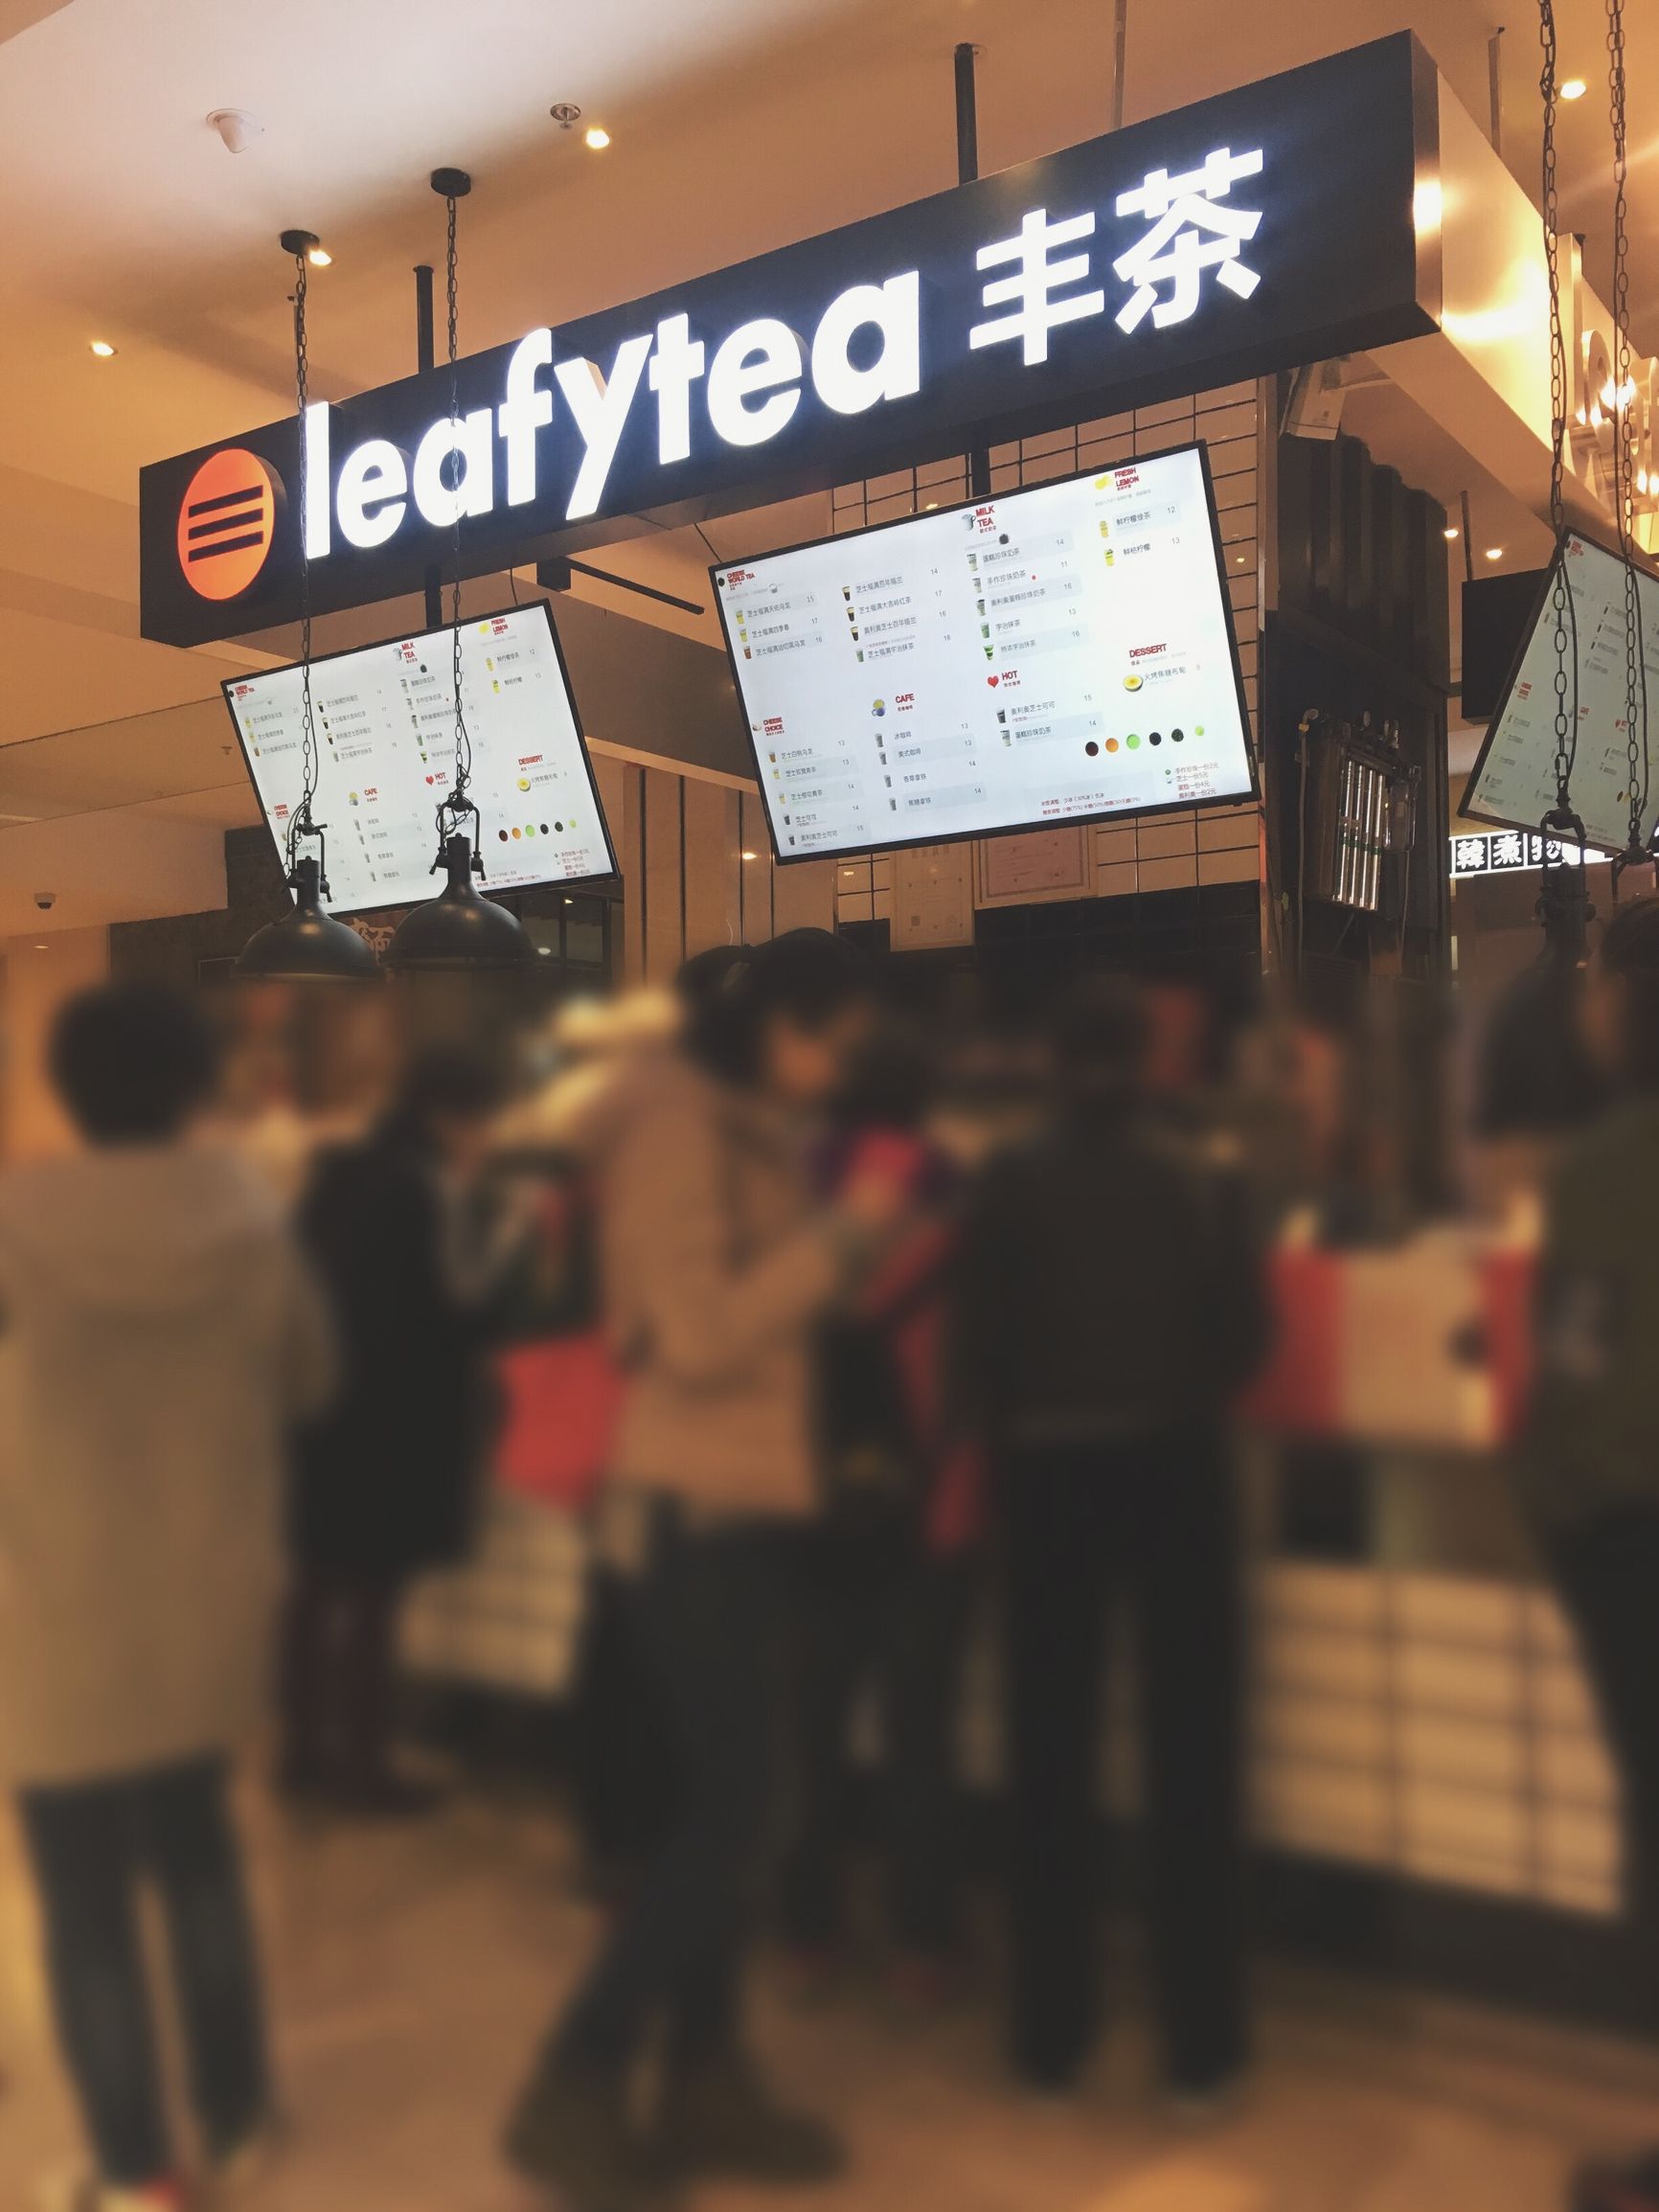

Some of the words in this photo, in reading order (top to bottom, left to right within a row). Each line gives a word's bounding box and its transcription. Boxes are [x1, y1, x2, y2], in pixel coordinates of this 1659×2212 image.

[967, 146, 1264, 366] 丰茶
[300, 269, 921, 521] leafytea
[1114, 467, 1136, 478] FRESH
[1116, 475, 1139, 487] LEMON
[975, 505, 995, 516] MILK
[977, 516, 993, 527] TEA
[1128, 643, 1168, 657] DESSERT
[1001, 671, 1018, 680] HOT
[895, 693, 915, 703] CAFE
